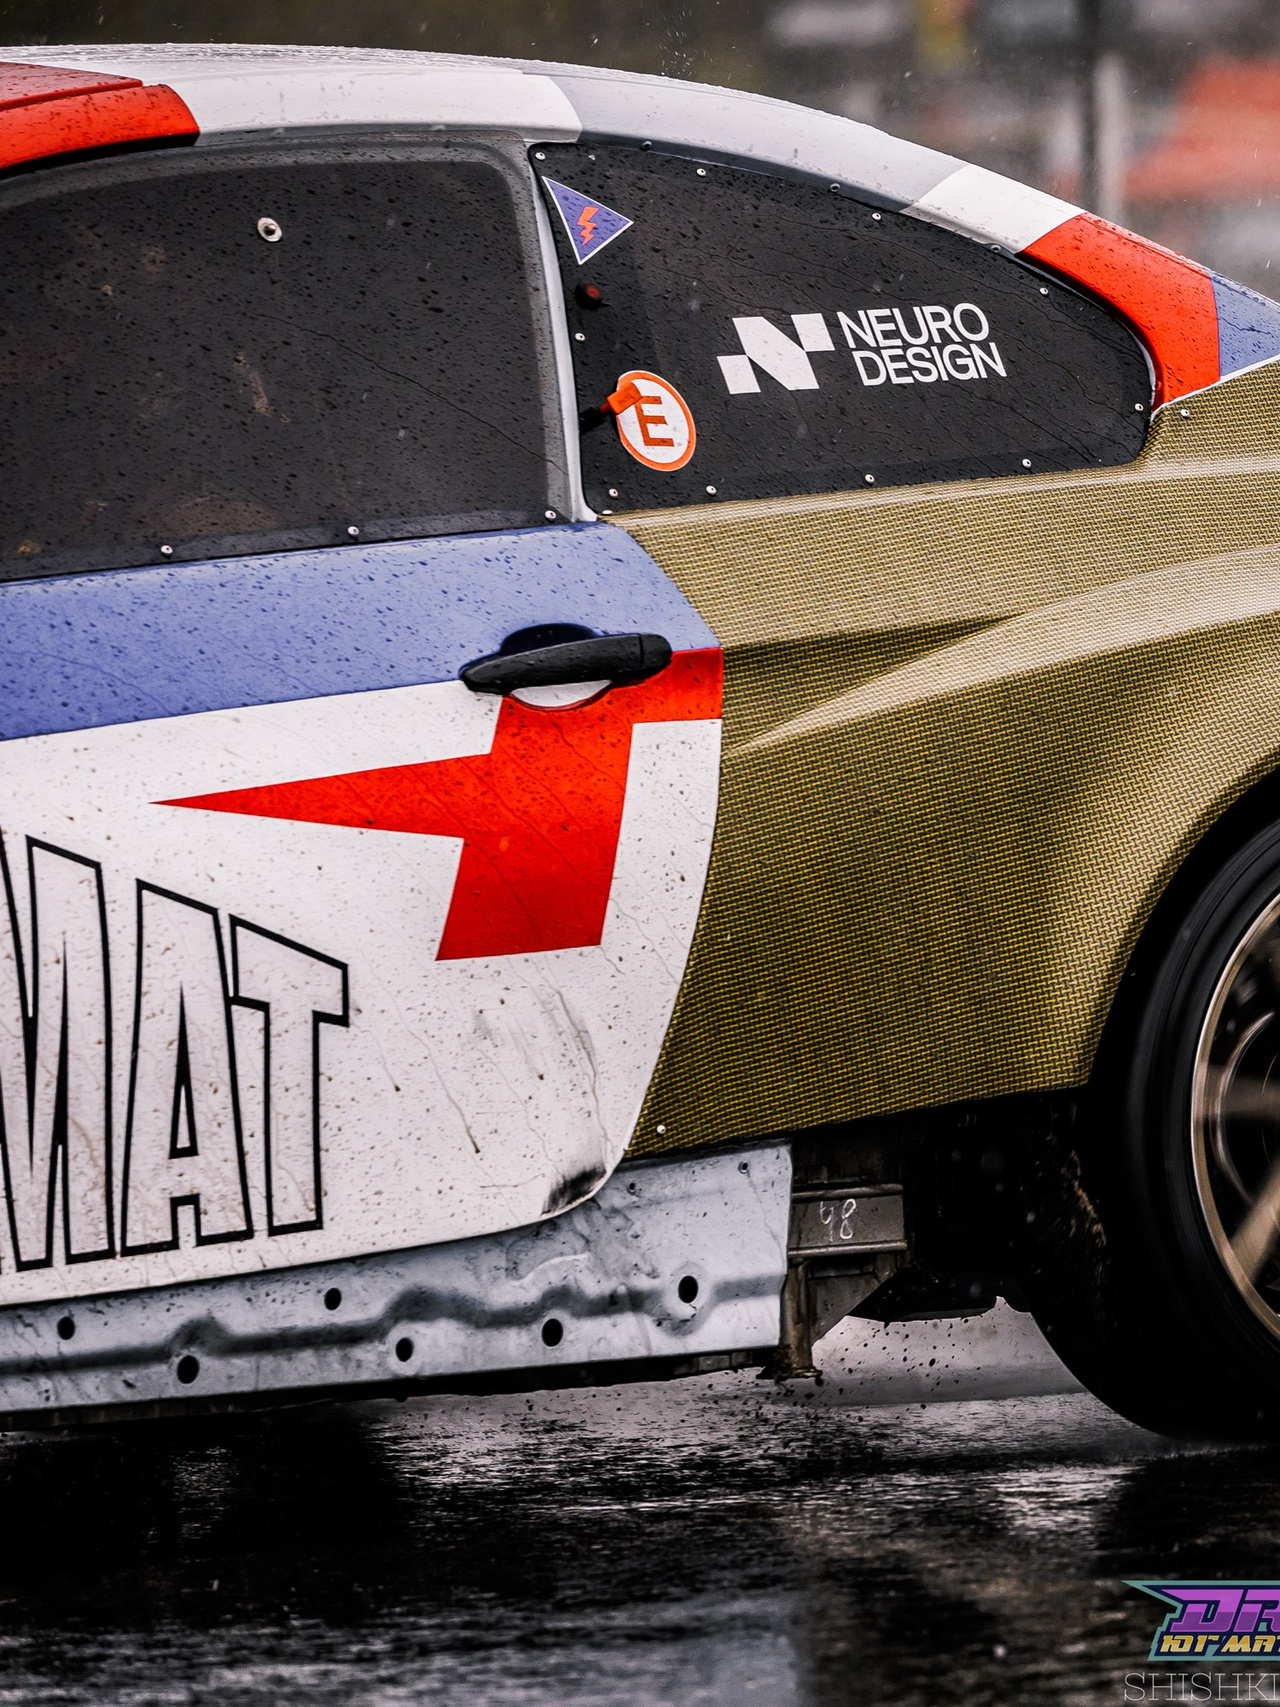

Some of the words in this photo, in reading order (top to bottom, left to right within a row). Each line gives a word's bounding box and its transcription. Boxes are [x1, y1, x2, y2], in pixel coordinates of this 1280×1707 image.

[837, 303, 989, 348] NEURO
[852, 342, 1007, 386] DESIGN
[634, 396, 675, 446] E
